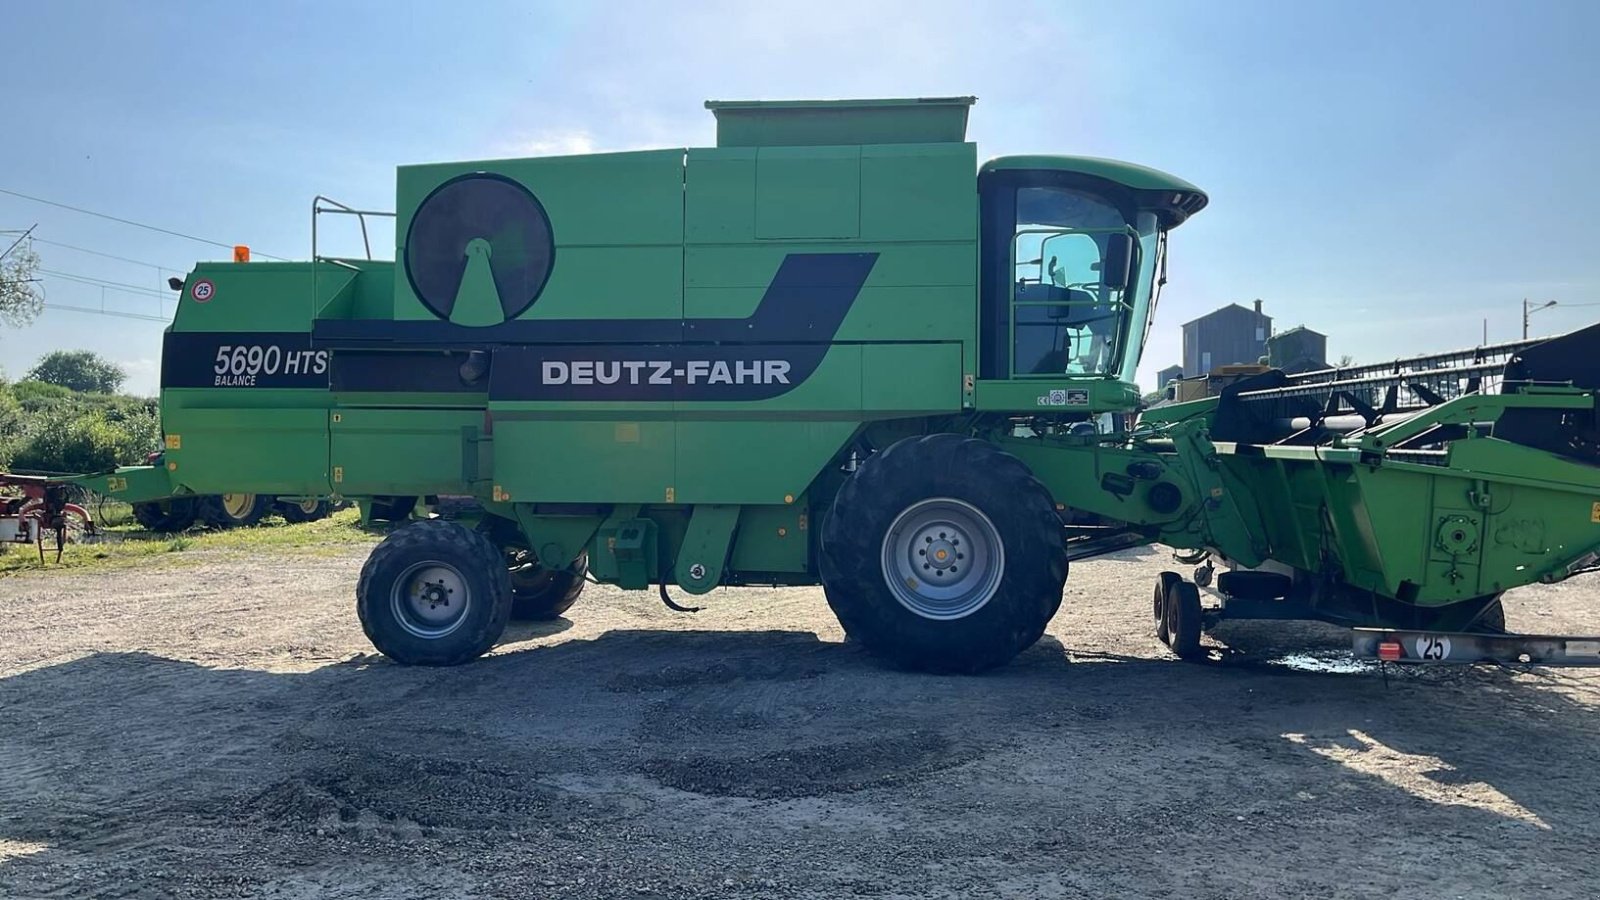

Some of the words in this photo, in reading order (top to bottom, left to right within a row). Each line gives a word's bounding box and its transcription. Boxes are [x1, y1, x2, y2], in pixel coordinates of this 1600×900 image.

[197, 285, 209, 296] 25
[214, 345, 281, 375] 5690
[284, 350, 328, 374] HTS
[542, 360, 791, 385] DEUTZ-FAHR
[214, 375, 256, 386] BALANCE
[1423, 635, 1443, 660] 25
